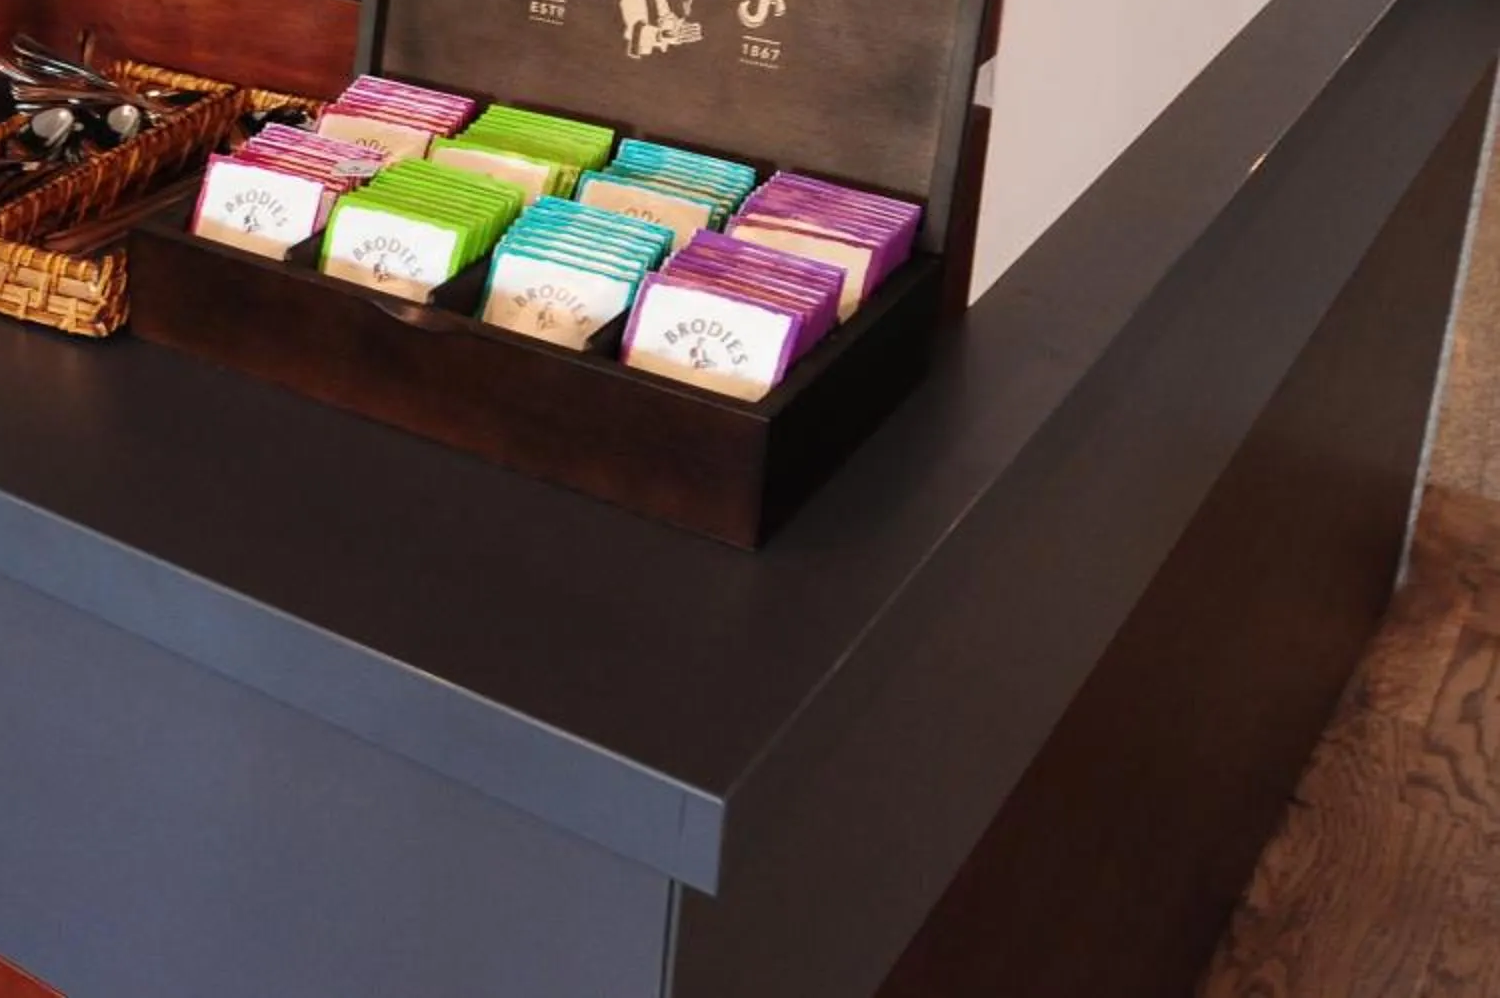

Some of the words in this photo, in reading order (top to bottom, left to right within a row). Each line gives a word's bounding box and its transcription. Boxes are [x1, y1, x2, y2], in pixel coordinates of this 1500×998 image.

[741, 43, 782, 63] 1867
[353, 236, 423, 277] BRODIES
[512, 284, 592, 326] BRODIES
[664, 318, 749, 365] BRODIES
